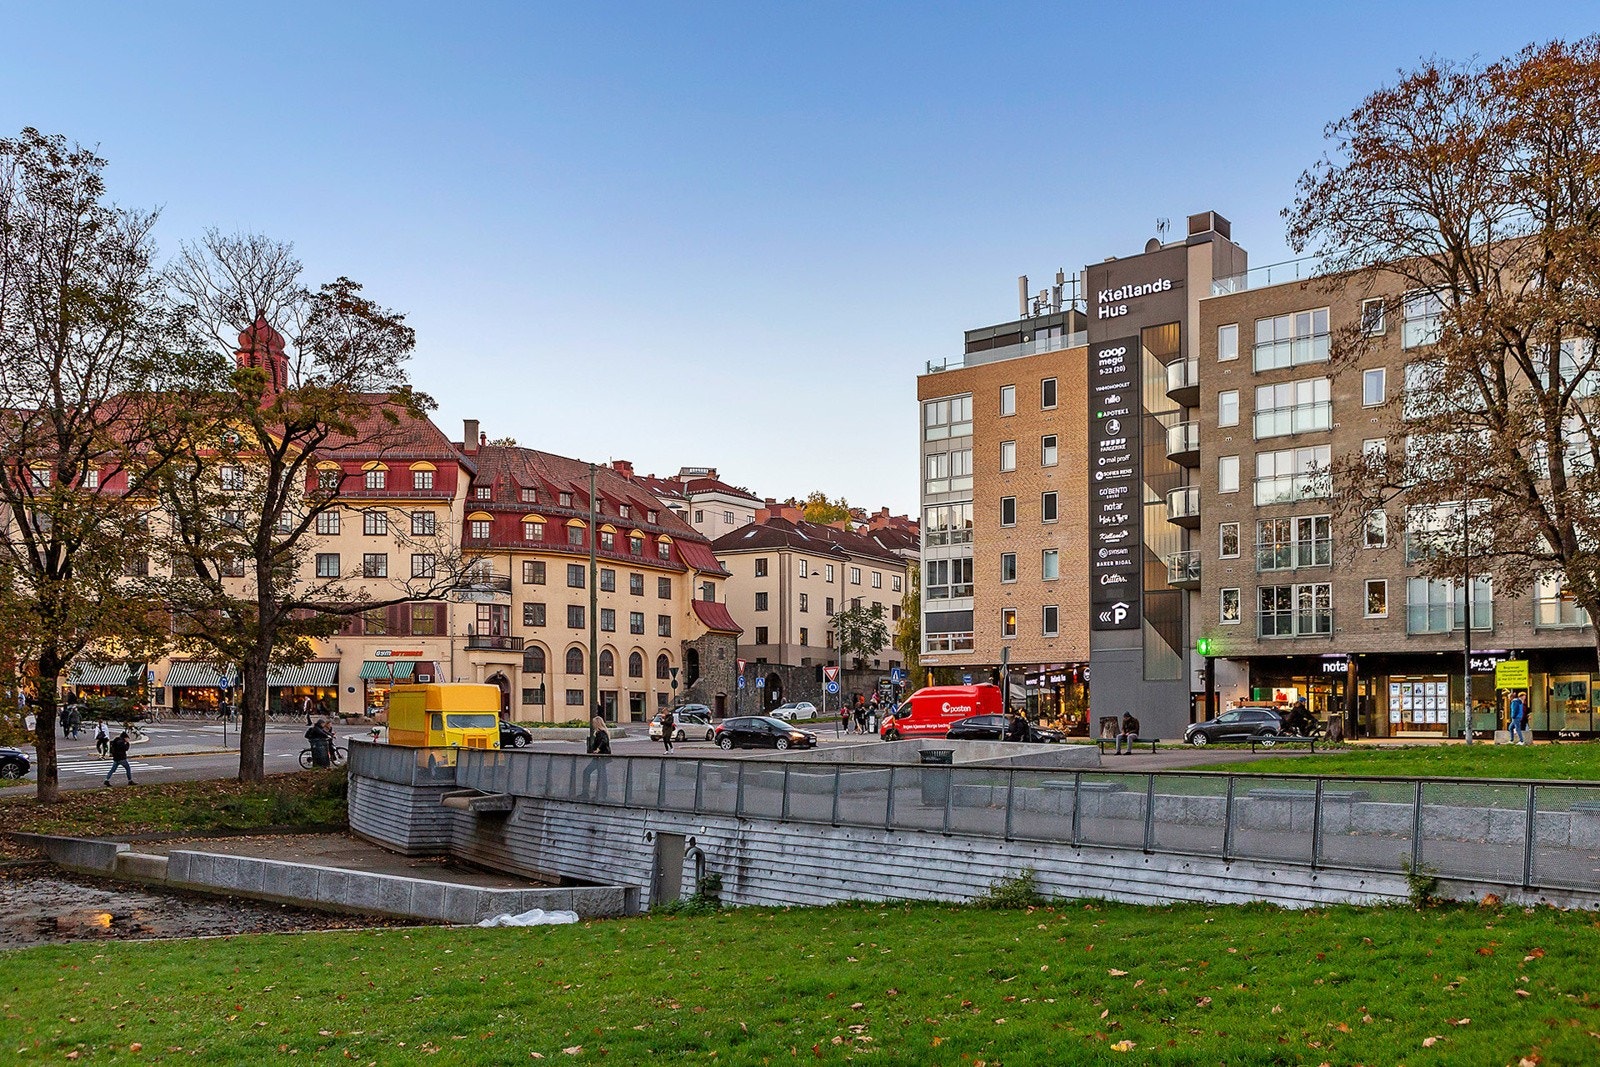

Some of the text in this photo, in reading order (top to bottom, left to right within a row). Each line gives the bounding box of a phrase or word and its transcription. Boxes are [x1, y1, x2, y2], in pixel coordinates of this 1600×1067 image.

[1098, 278, 1172, 303] Kiellands
[1098, 304, 1128, 319] Hus
[1099, 346, 1126, 358] coop
[1099, 357, 1123, 366] mega
[1103, 502, 1123, 512] notar
[1115, 608, 1127, 624] P
[950, 705, 972, 713] posten
